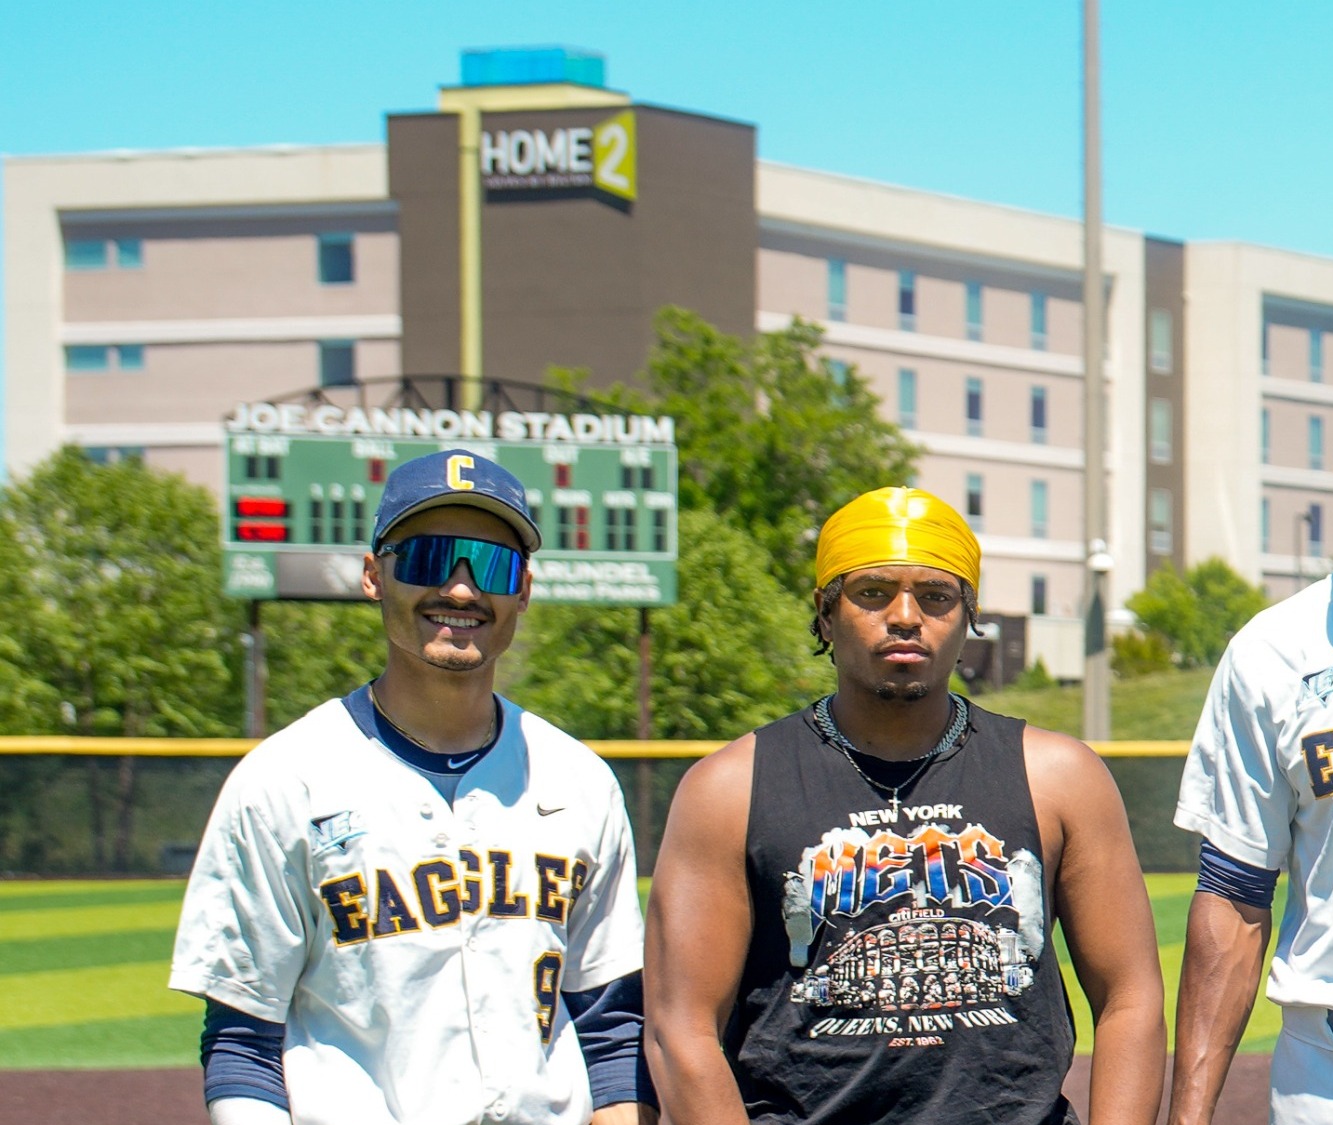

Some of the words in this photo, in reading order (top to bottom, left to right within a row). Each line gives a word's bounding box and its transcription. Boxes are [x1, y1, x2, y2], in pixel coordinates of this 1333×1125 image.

[480, 127, 593, 176] HOME
[598, 123, 630, 189] 2
[226, 402, 307, 432] JOE
[312, 405, 494, 438] CANNON
[497, 411, 675, 444] STADIUM
[447, 454, 475, 490] C
[849, 809, 898, 828] NEW
[902, 803, 963, 820] YORK
[320, 845, 589, 948] EAGLES
[808, 823, 1022, 930] METS
[533, 950, 563, 1045] 9
[908, 1012, 954, 1033] NEW
[955, 1006, 1018, 1028] YORK
[888, 1037, 914, 1047] EST.
[916, 1035, 945, 1046] 1962
